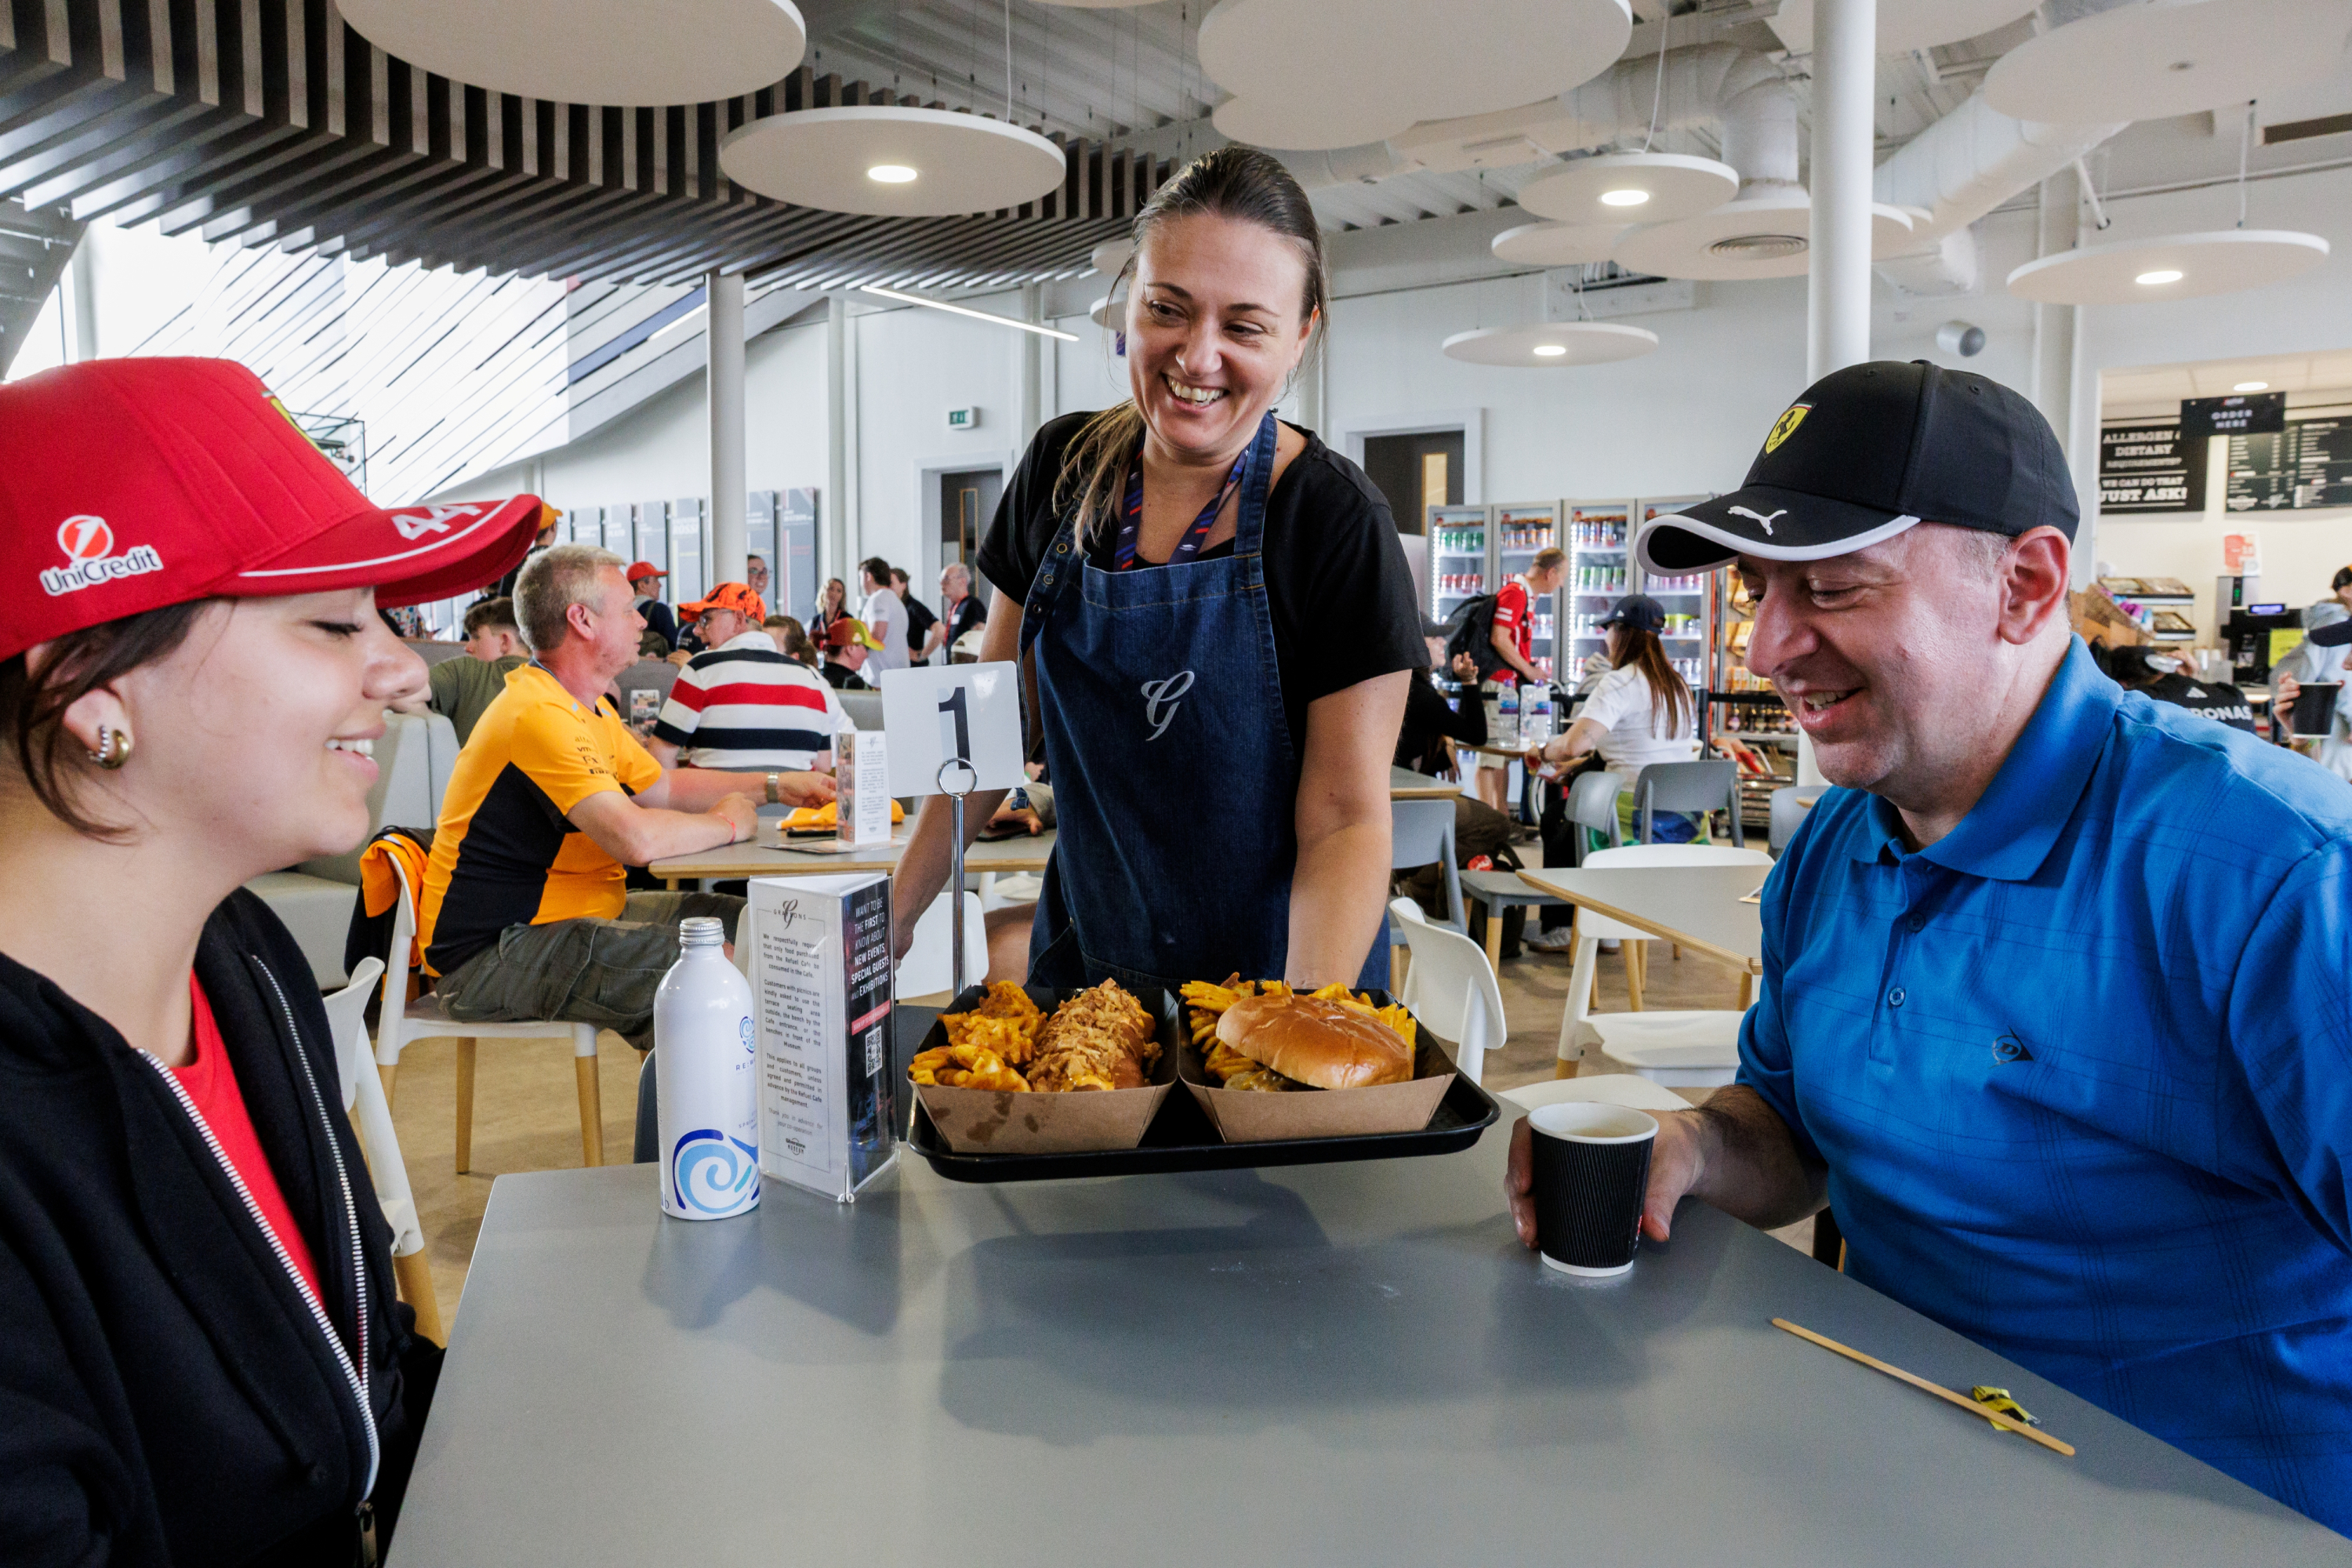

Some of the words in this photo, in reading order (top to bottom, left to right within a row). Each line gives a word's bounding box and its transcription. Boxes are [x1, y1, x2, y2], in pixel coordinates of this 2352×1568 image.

[2103, 430, 2174, 444] ALLERGEN
[2114, 445, 2174, 457] DIETARY
[2100, 489, 2142, 503] JUST
[2143, 487, 2187, 500] ASK!
[44, 550, 158, 593] UniCredit
[2187, 706, 2253, 720] RONAS
[938, 686, 971, 770] 1
[856, 902, 870, 918] WANT
[870, 900, 877, 909] TO
[877, 897, 883, 909] BE
[855, 920, 864, 935] THE
[865, 914, 878, 929] FIRST
[879, 913, 884, 923] TO
[773, 936, 798, 946] respectfully
[855, 936, 870, 950] KNOW
[870, 927, 885, 942] ABOUT
[855, 952, 867, 967] NEW
[851, 966, 872, 985] SPECIAL
[872, 955, 889, 973] GUESTS
[764, 978, 786, 989] Customers
[764, 989, 777, 998] kindly
[787, 1005, 803, 1014] seating
[765, 1027, 782, 1036] benches
[776, 1057, 792, 1065] applies
[807, 1065, 822, 1074] groups
[779, 1067, 803, 1079] customers,
[767, 1073, 781, 1081] agreed
[793, 1080, 815, 1091] permitted
[767, 1082, 784, 1091] advance
[784, 1086, 790, 1094] by
[798, 1091, 811, 1099] Refuel
[798, 1117, 814, 1127] advance
